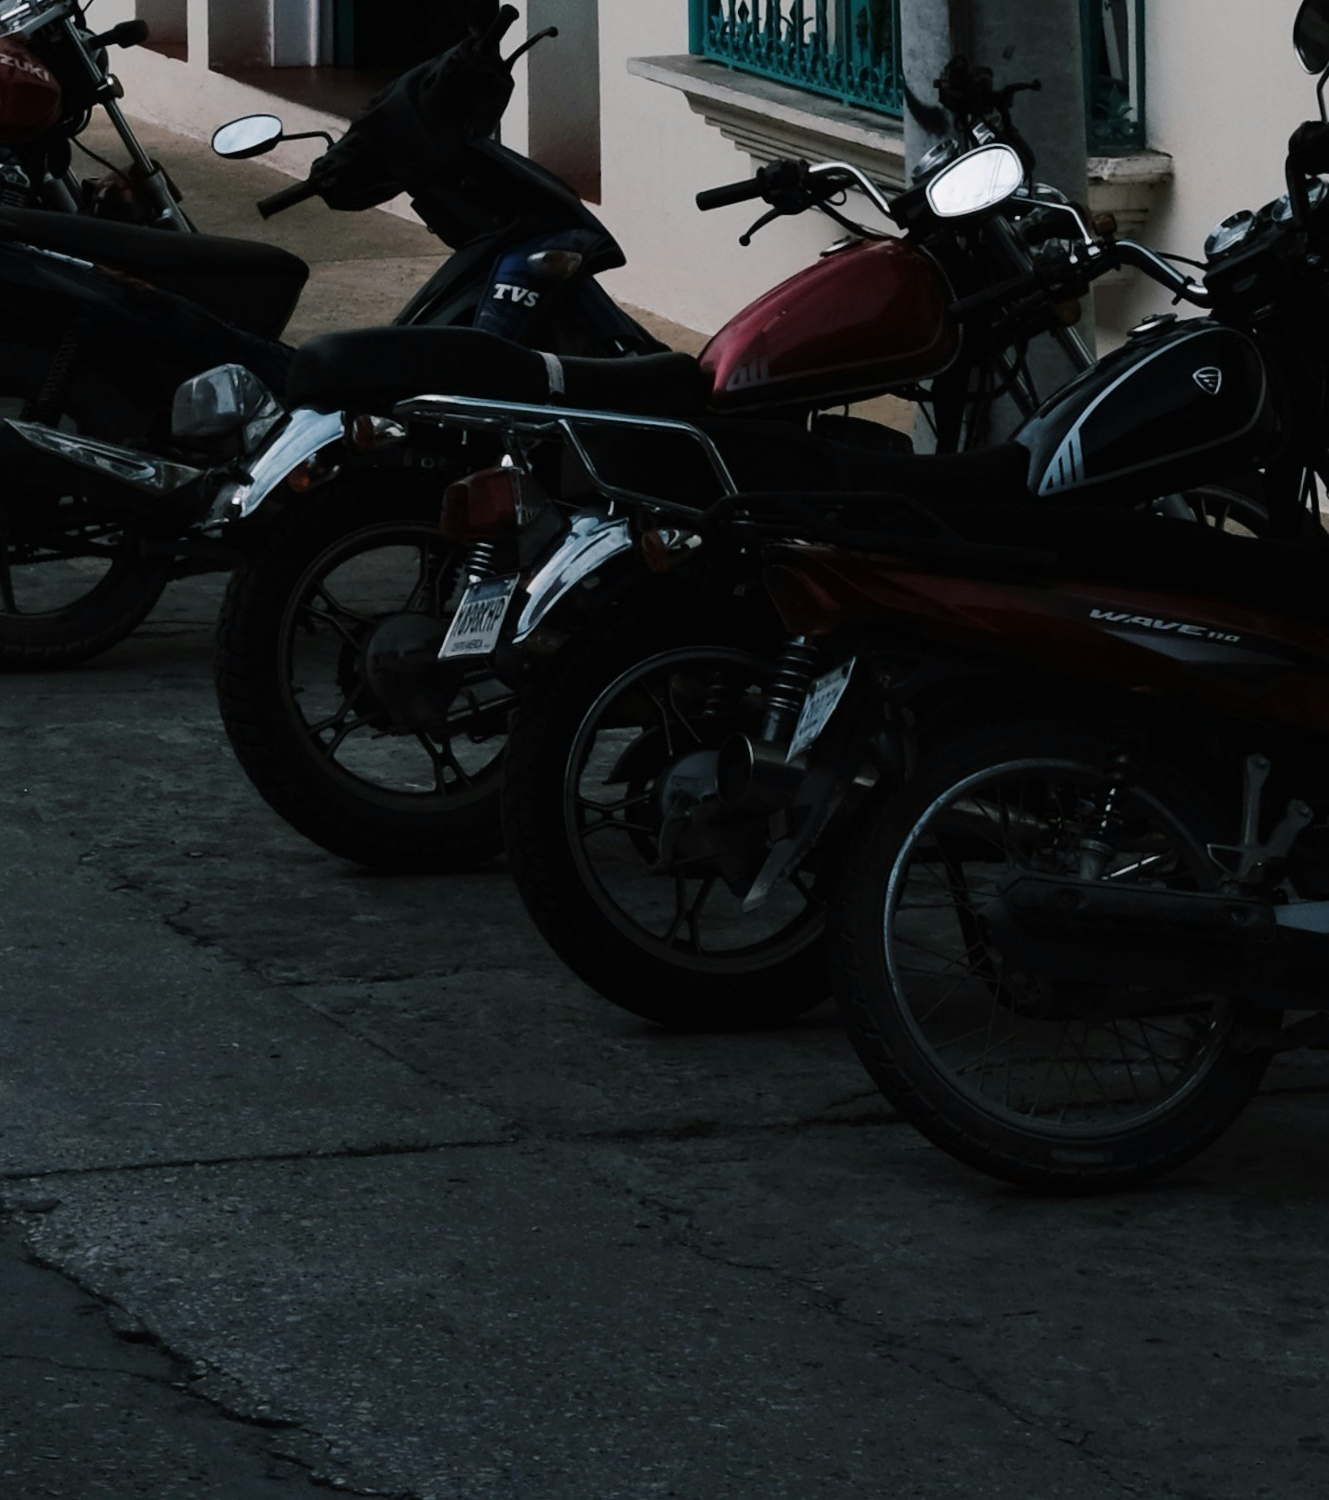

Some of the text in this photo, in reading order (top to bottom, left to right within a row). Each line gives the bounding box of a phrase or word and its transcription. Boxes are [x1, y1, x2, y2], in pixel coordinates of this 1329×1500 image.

[492, 283, 541, 308] TVS
[1089, 608, 1242, 643] WAVE 110
